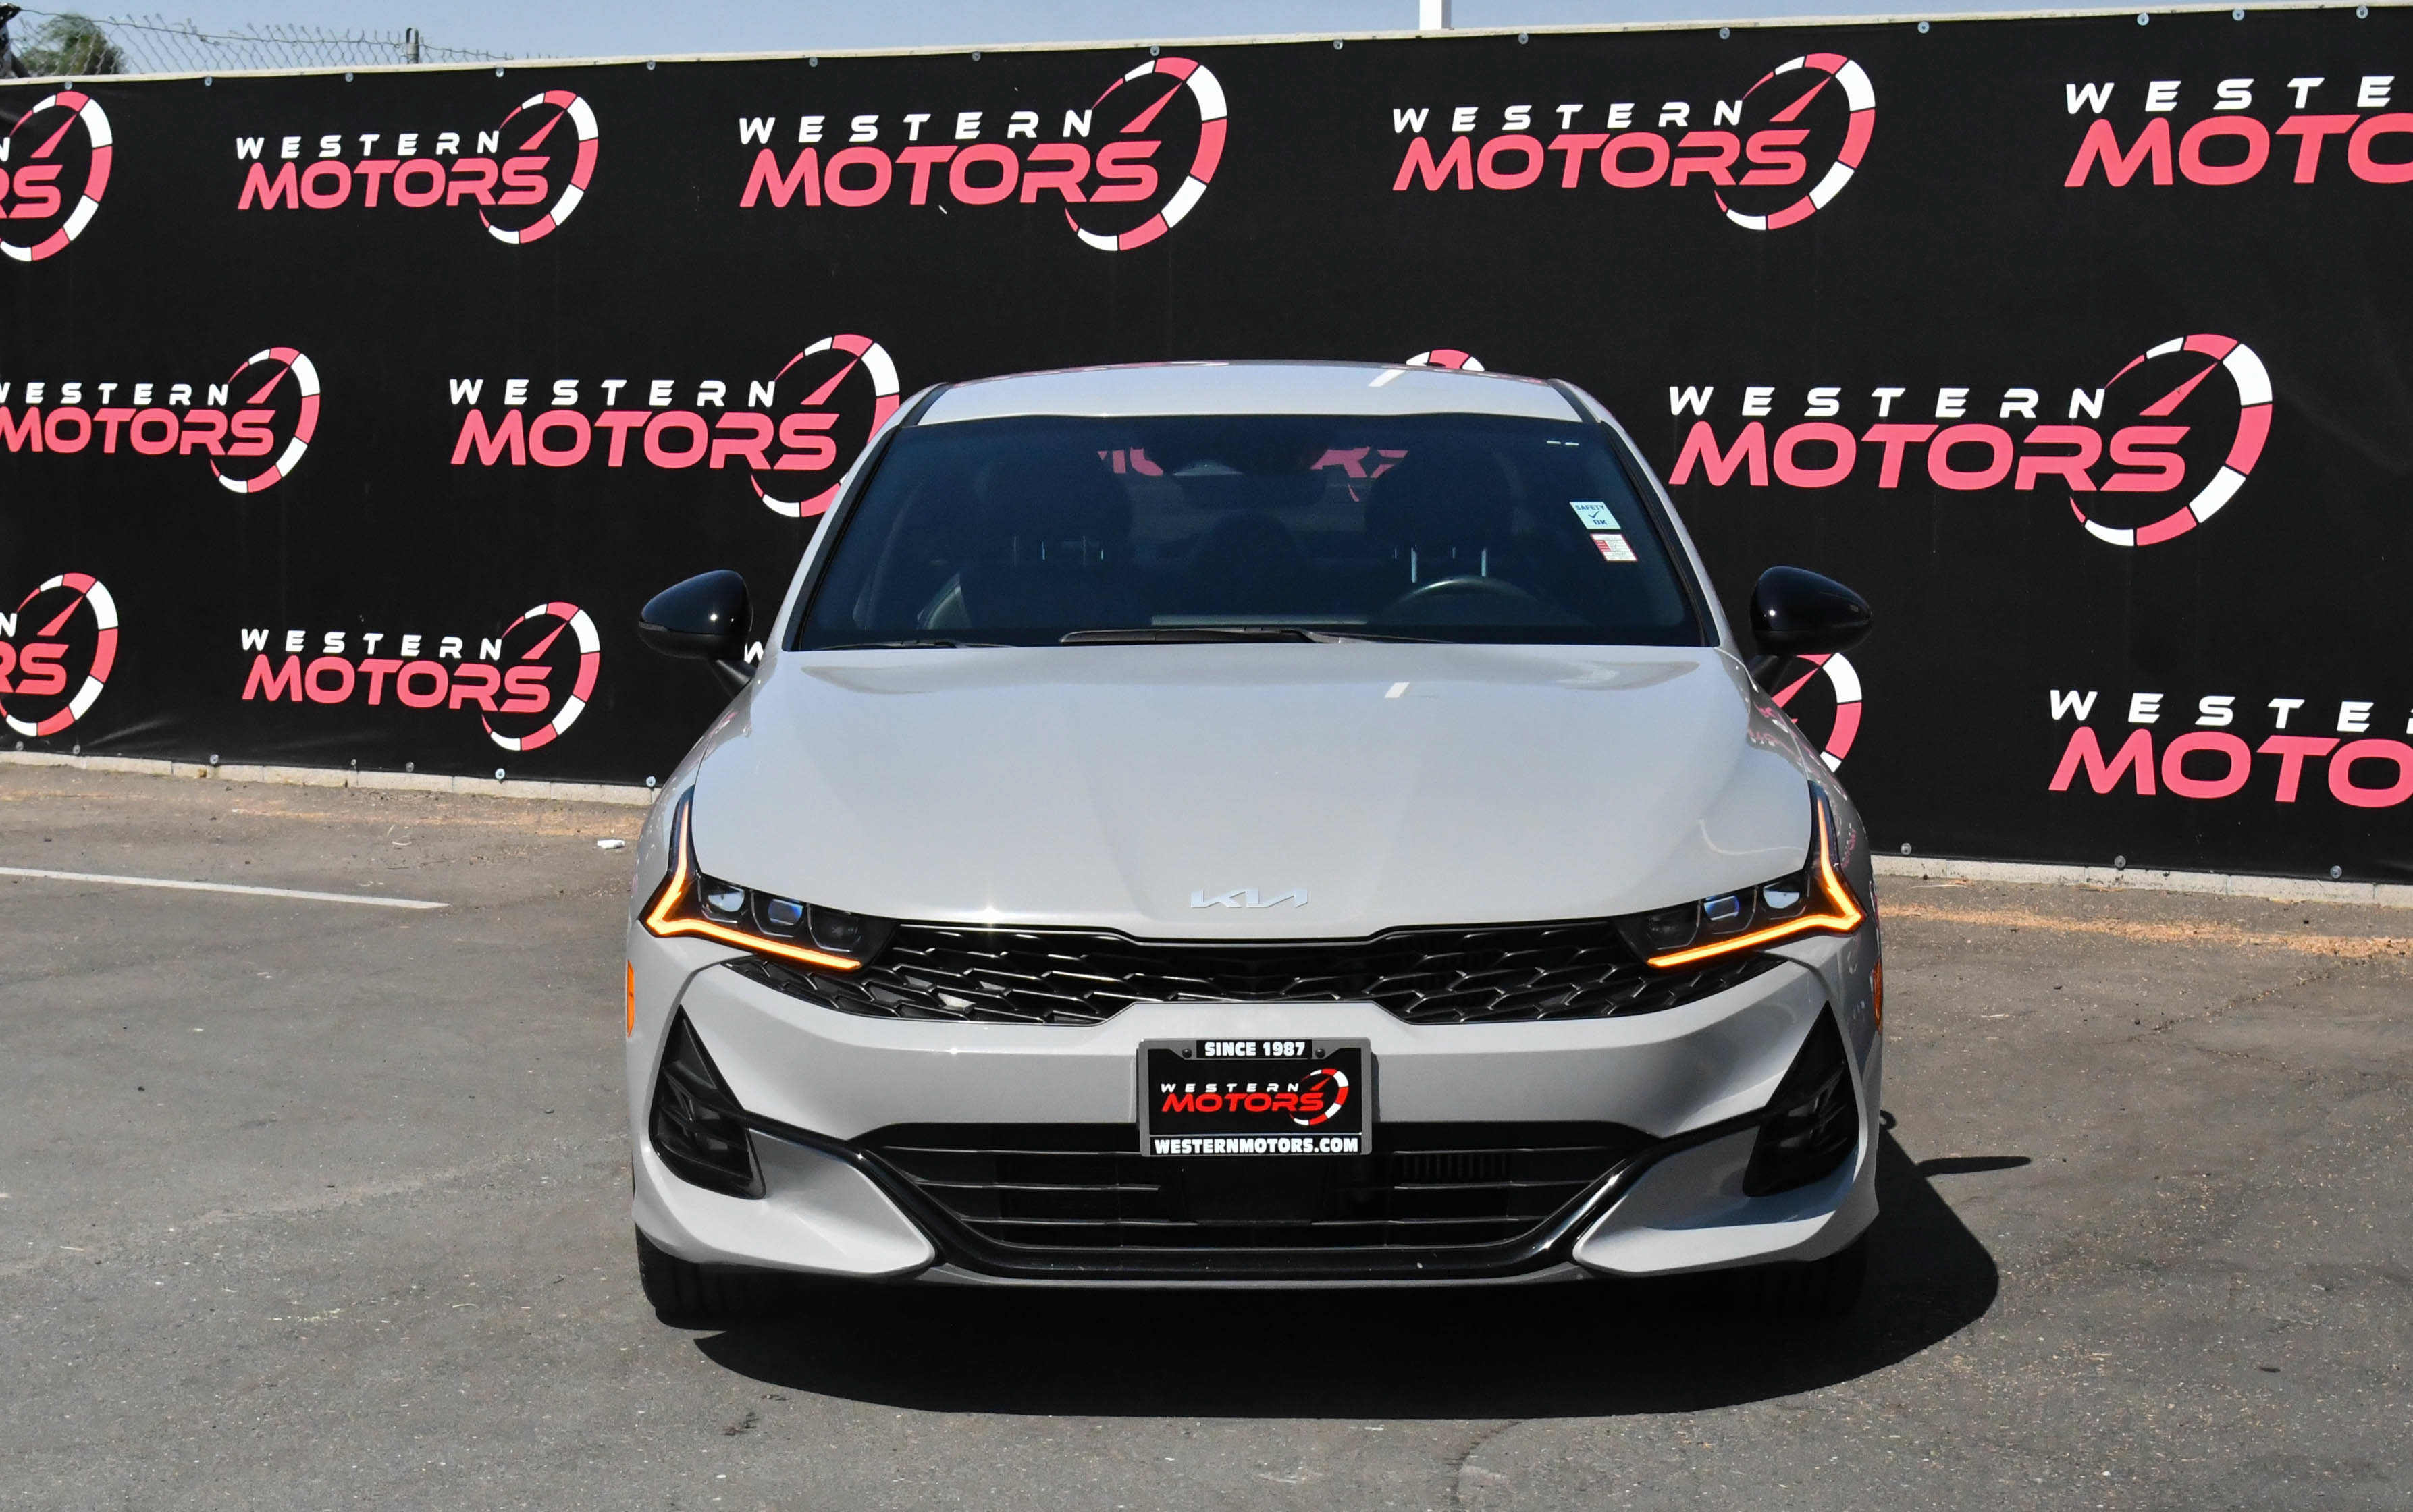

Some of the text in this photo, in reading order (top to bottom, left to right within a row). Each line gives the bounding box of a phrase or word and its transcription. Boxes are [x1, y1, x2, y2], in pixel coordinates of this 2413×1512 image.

[2066, 76, 2395, 114] WESTE
[739, 109, 1092, 144] WESTERN
[1393, 100, 1743, 134] WESTERN
[236, 130, 500, 159] WESTERN
[1392, 129, 1810, 191] MOTORS
[2063, 113, 2413, 187] MOTO
[237, 156, 550, 210] MOTORS
[739, 140, 1162, 208] MOTORS
[450, 379, 776, 408] WESTERN
[1669, 386, 2105, 419] WESTERN
[450, 408, 840, 470] MOTORS
[1668, 420, 2192, 493] MOTORS
[241, 628, 502, 661] WESTERN
[242, 653, 552, 713] MOTORS
[2050, 689, 2413, 734] WESTE
[2048, 726, 2413, 808] MOTO
[1190, 888, 1308, 908] KIA
[1204, 1042, 1305, 1056] SINCE 1987
[1160, 1083, 1300, 1094] WESTERN
[1161, 1092, 1324, 1113] MOTORS
[1155, 1138, 1358, 1154] WESTERNMOTORS.COM
